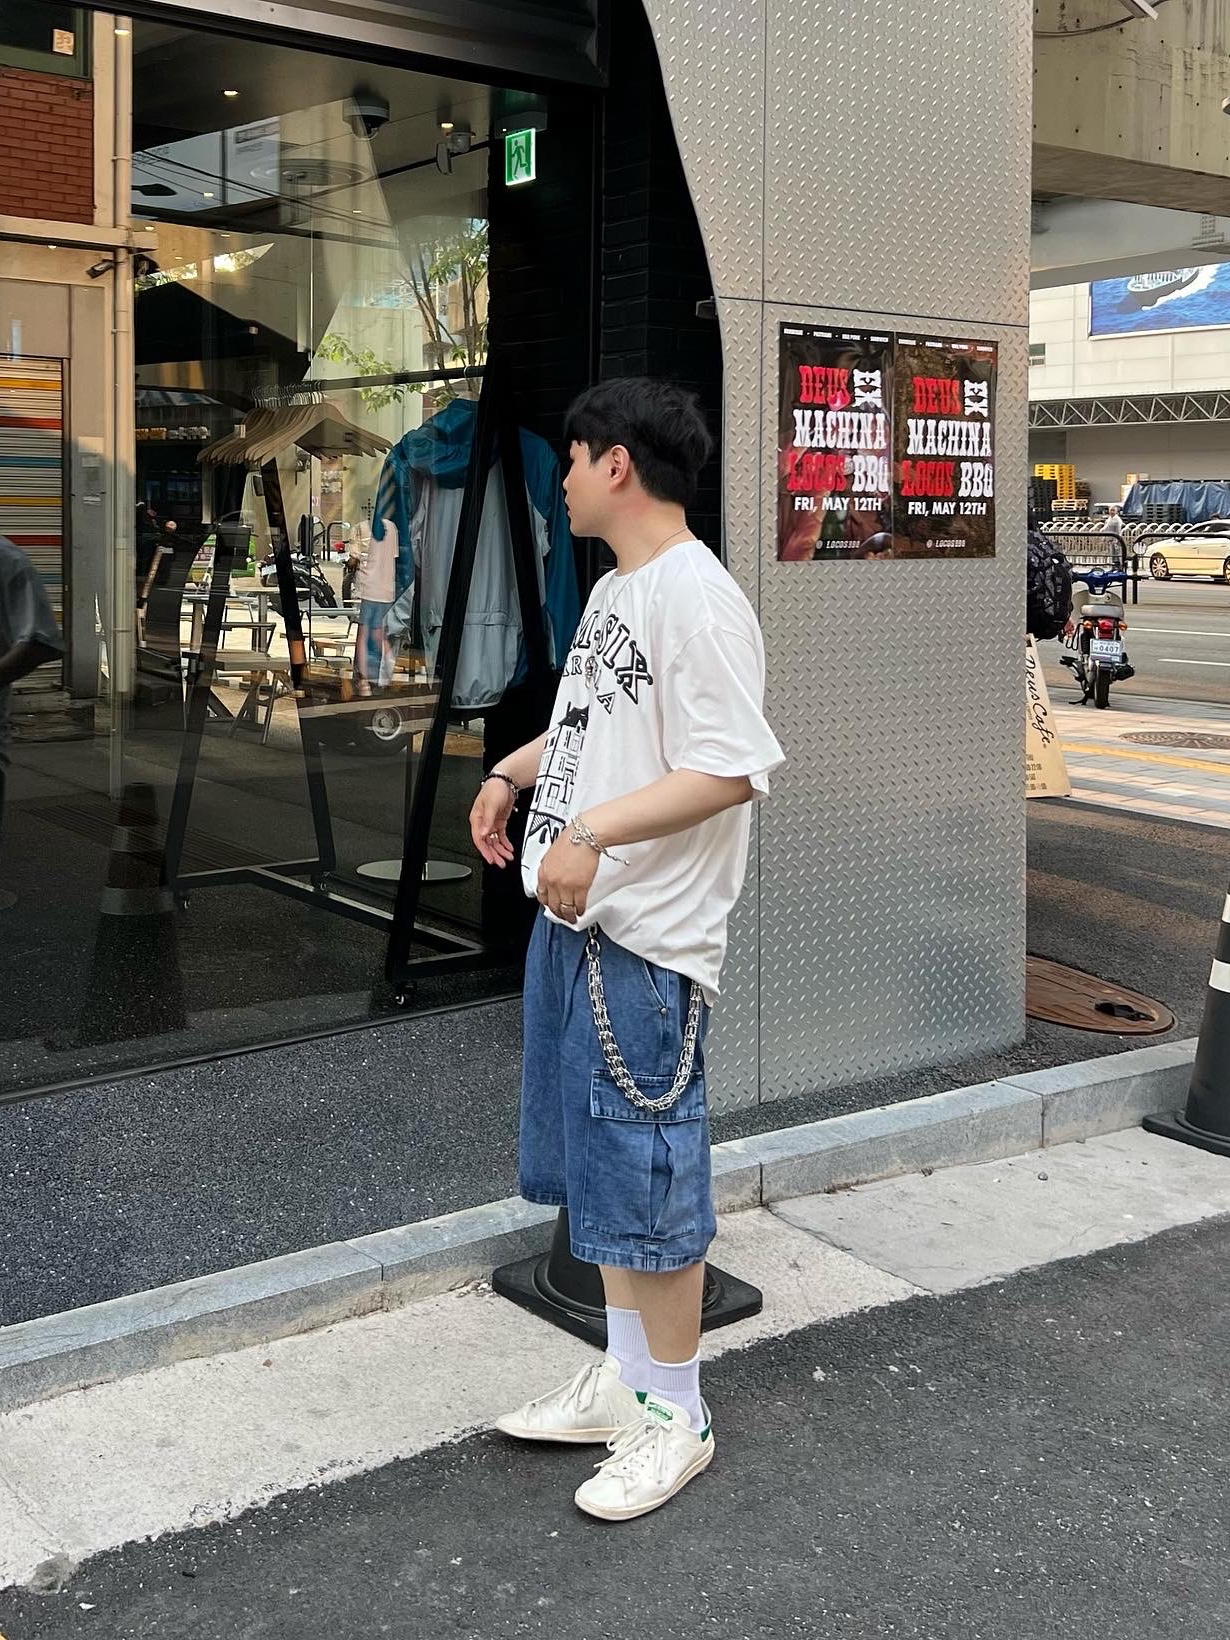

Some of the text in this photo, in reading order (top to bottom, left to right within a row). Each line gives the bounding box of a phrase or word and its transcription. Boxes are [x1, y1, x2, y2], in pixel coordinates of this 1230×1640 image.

[799, 365, 851, 410] DEUS
[912, 376, 961, 415] DEUS
[793, 409, 887, 449] MACHINA
[906, 418, 992, 457] MACHINA
[787, 452, 889, 493] LOCOS BBQ
[901, 460, 993, 497] LOCOS BBQ
[794, 496, 882, 512] FRI, MAY 12TH
[907, 501, 986, 516] FRI, MAY 12TH
